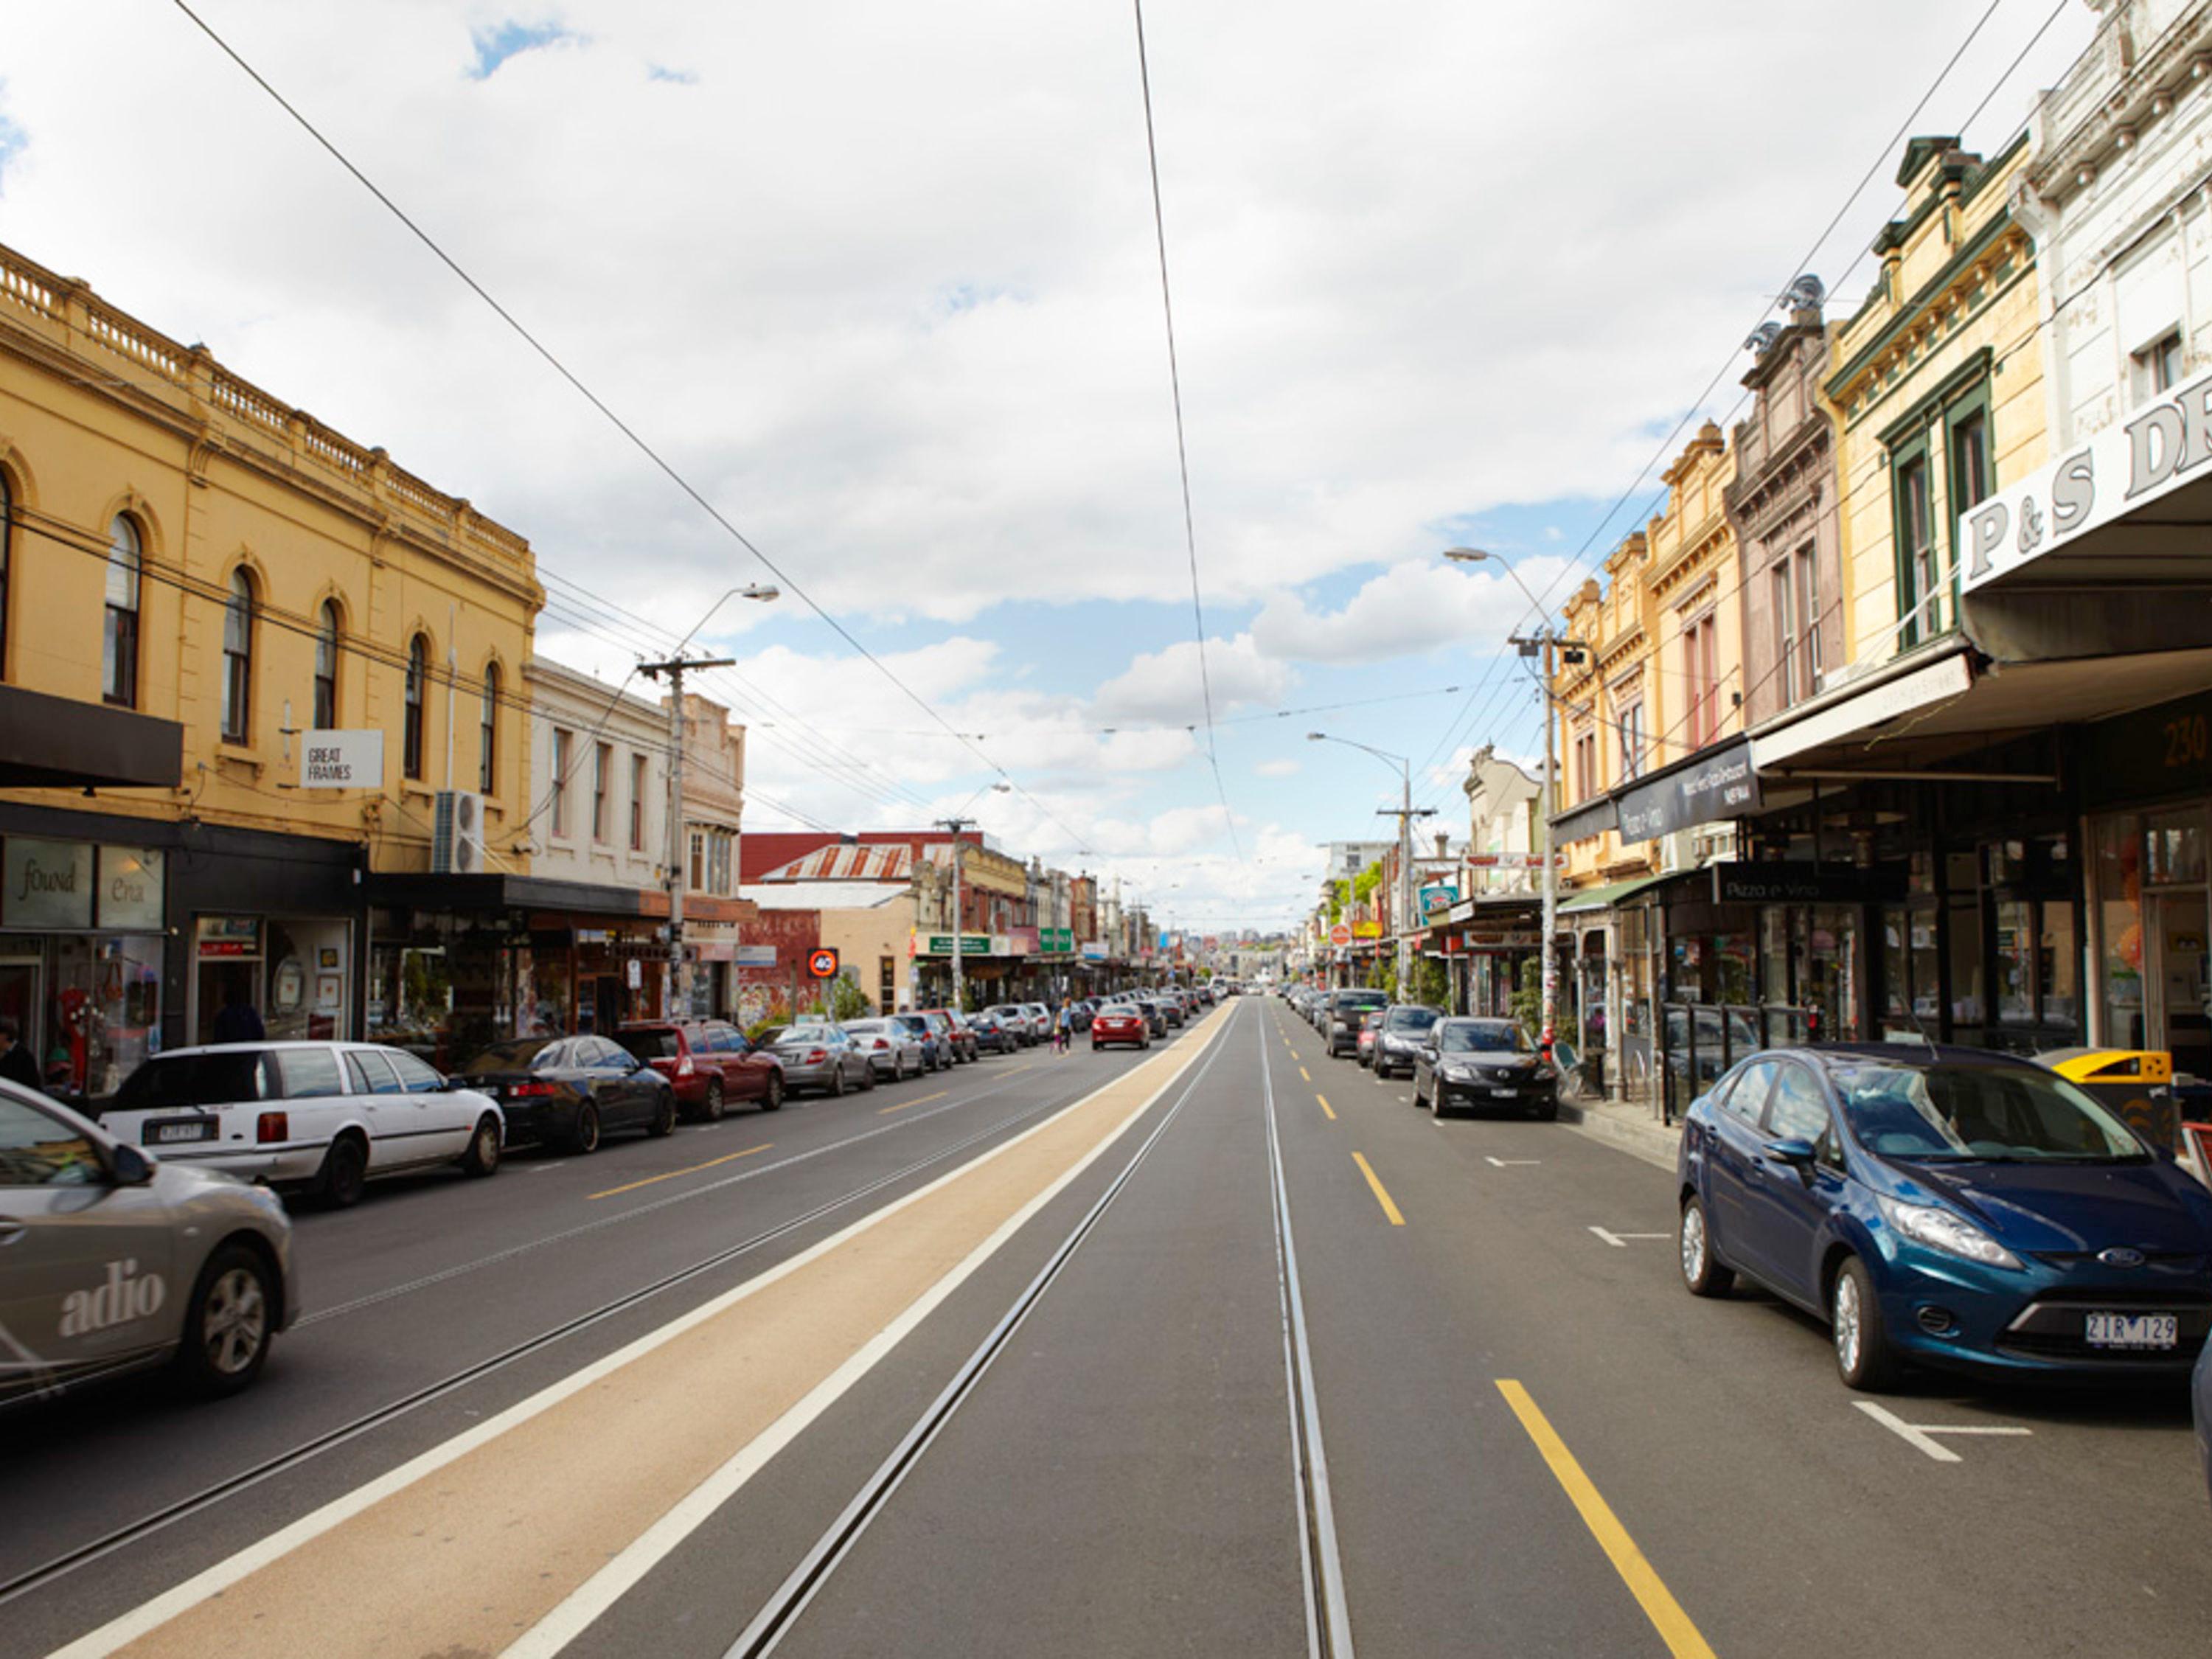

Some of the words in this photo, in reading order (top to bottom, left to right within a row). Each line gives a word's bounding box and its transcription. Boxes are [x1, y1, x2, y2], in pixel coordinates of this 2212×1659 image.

[307, 748, 341, 763] GREAT
[307, 764, 352, 780] FRAMES
[18, 857, 77, 902] found
[1726, 881, 1766, 898] Pizza
[815, 957, 832, 970] 40
[2142, 1318, 2175, 1339] 129
